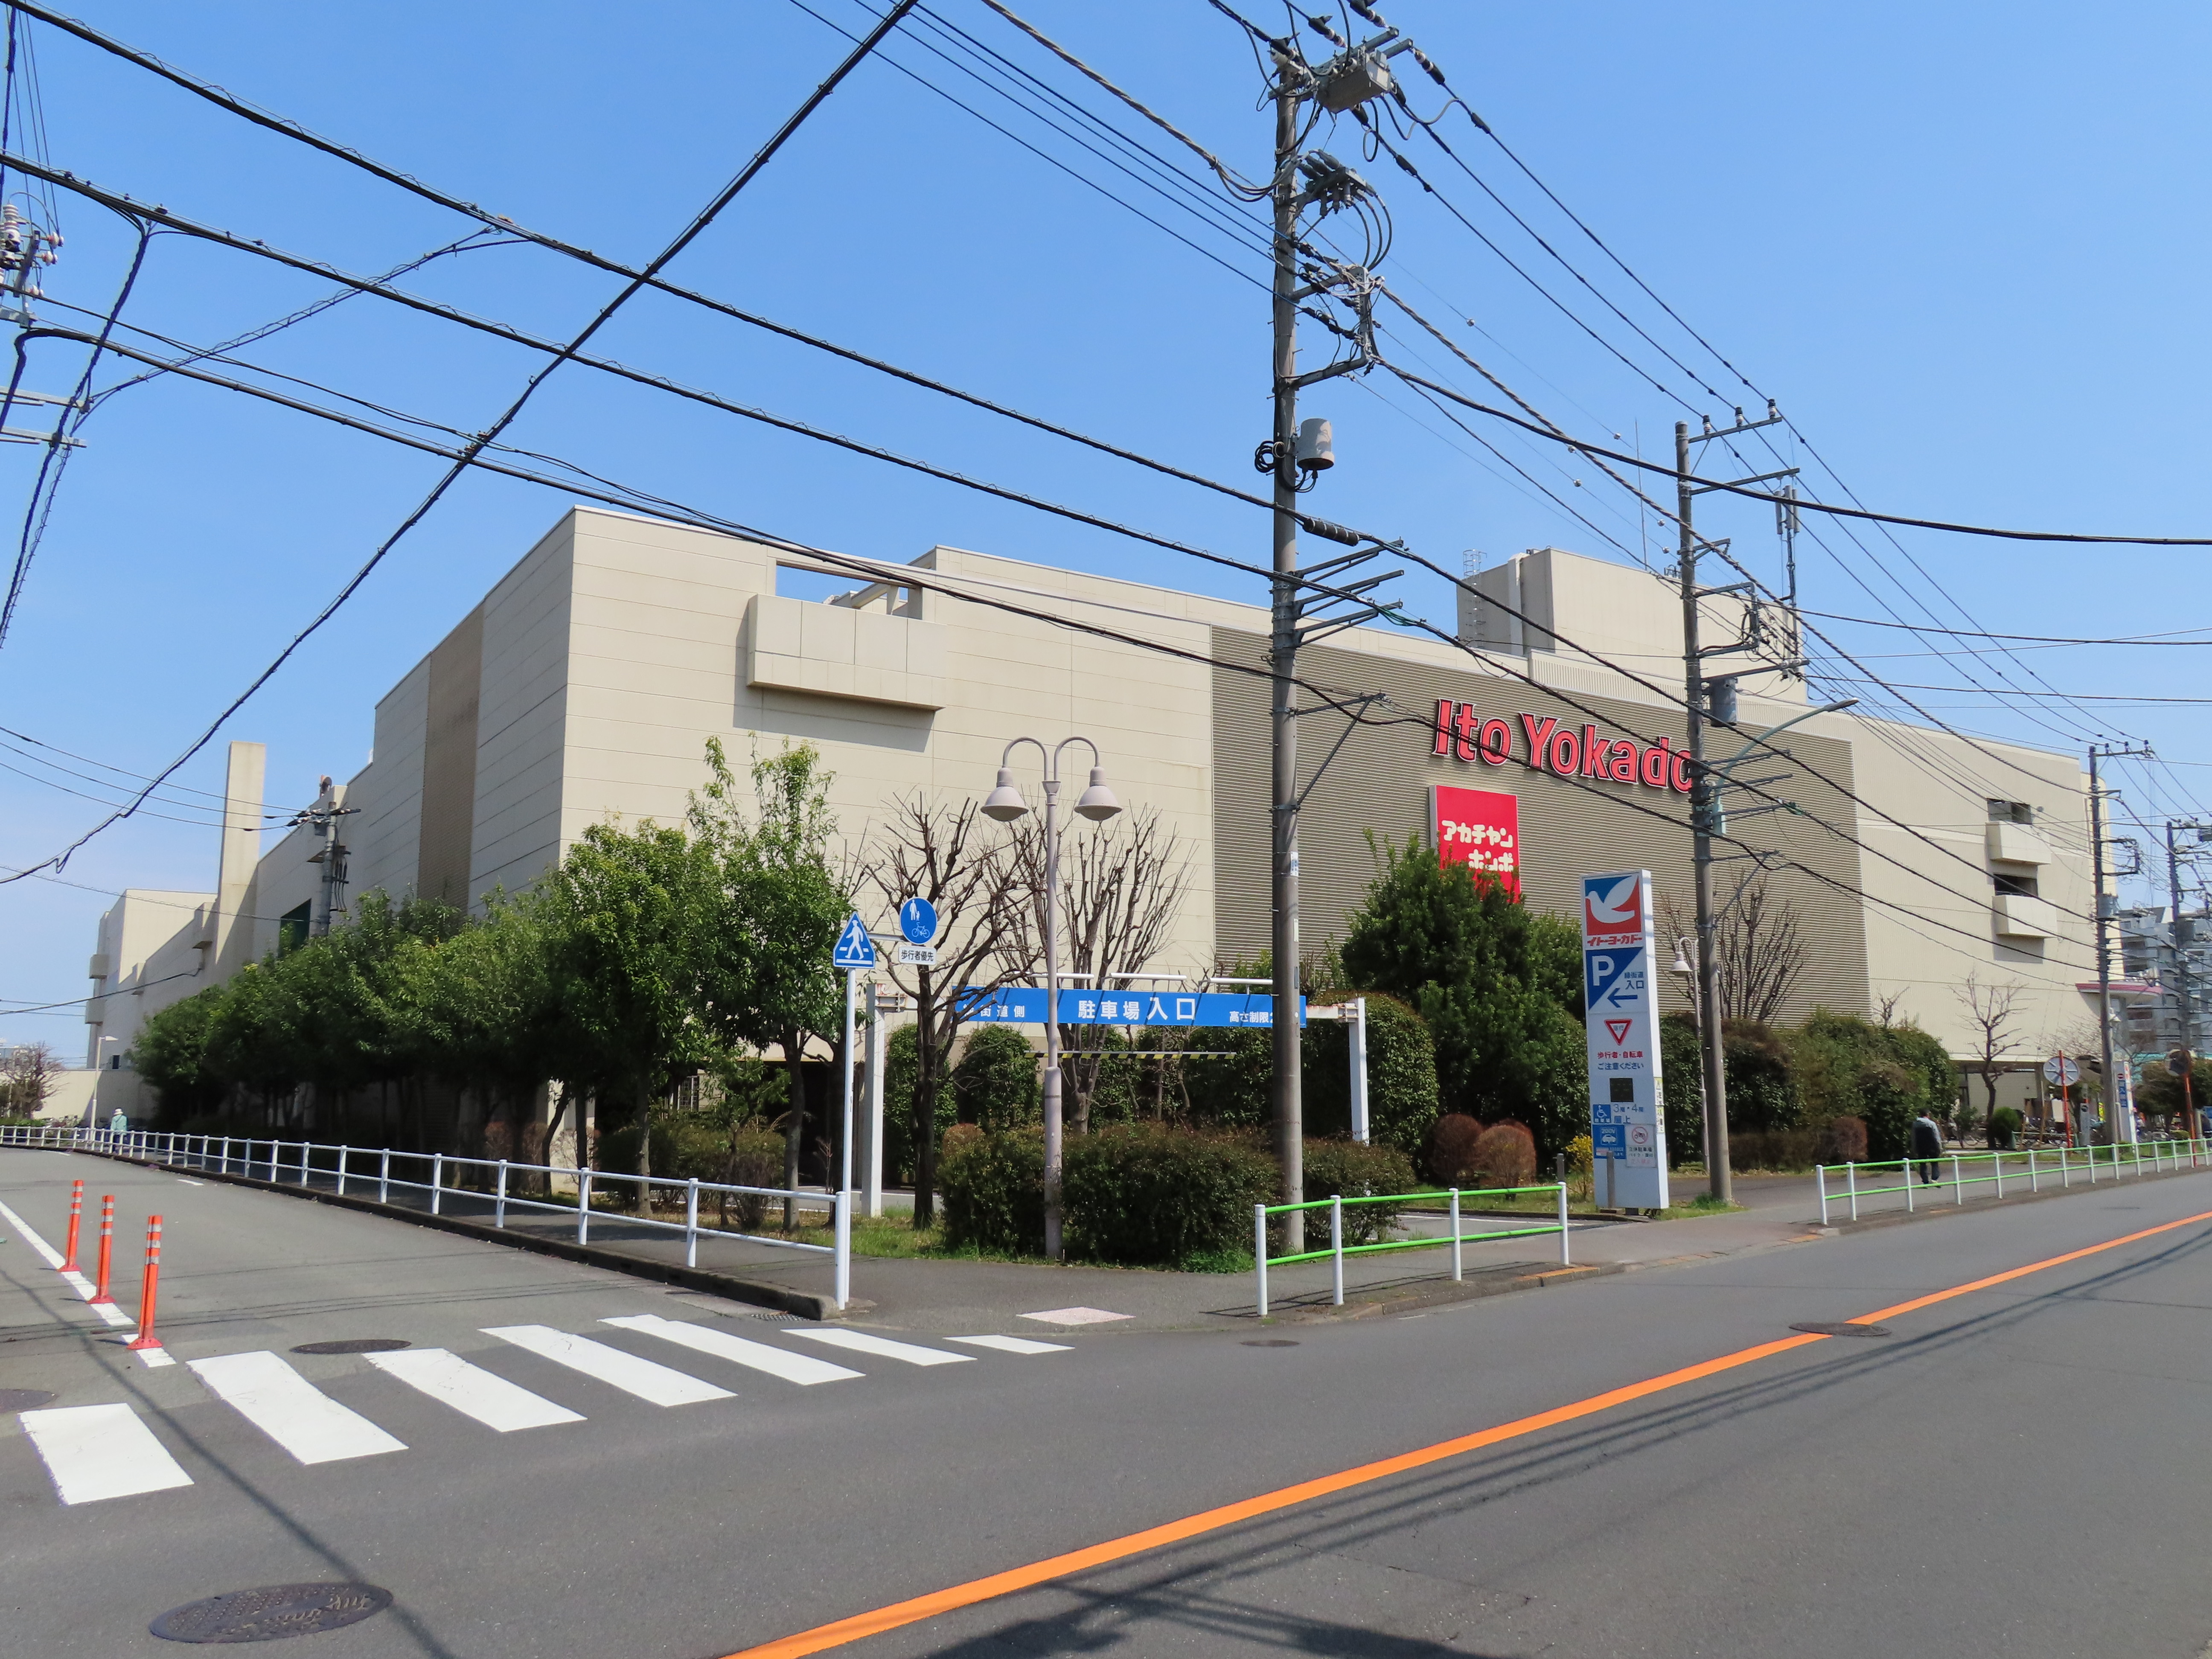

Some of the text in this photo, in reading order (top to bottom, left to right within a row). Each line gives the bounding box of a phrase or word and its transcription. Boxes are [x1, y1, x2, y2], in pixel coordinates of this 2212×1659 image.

[1432, 698, 1512, 766] Ito
[1441, 820, 1513, 848] アカチャン
[1468, 849, 1513, 872] ホンポ
[1587, 934, 1642, 946] イトーヨーカドー
[901, 949, 934, 961] 歩行者優先
[1592, 955, 1615, 986] P
[1625, 980, 1644, 990] 入口
[1078, 997, 1196, 1020] 駐車場入口
